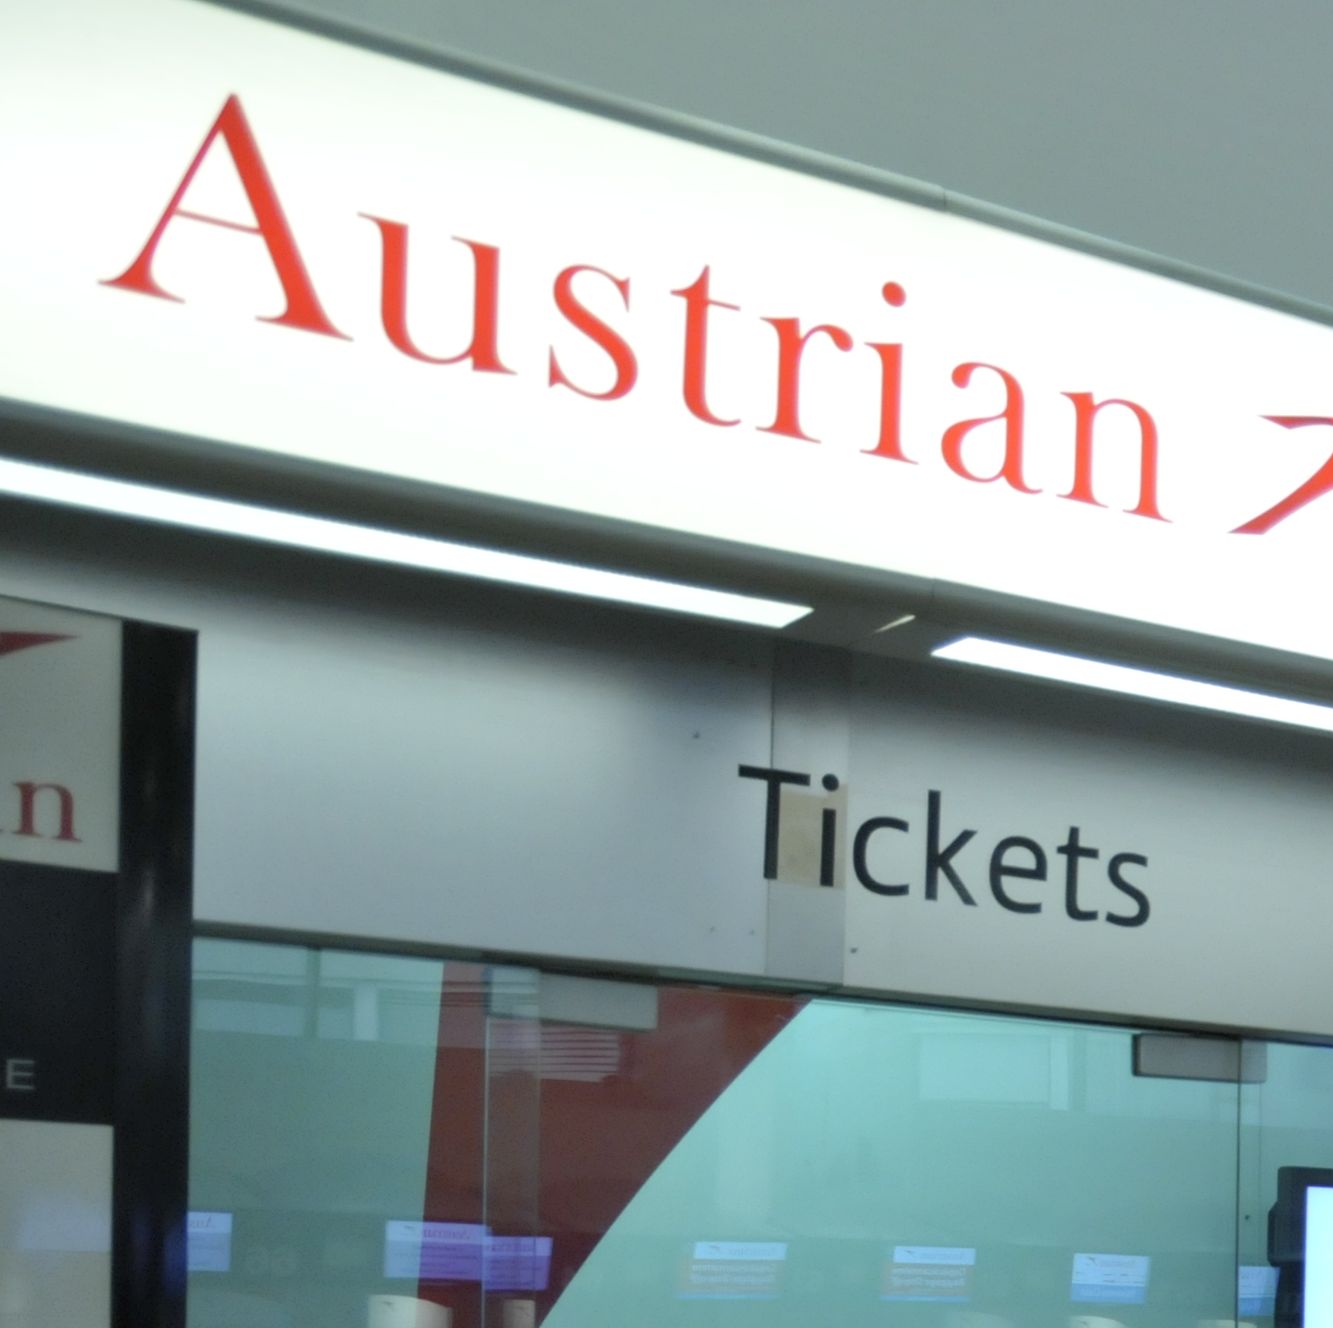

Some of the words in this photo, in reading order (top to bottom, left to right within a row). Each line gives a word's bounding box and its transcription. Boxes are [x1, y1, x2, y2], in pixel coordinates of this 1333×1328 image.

[97, 92, 1166, 522] Austrian
[0, 777, 83, 844] n
[737, 763, 1152, 929] Tickets
